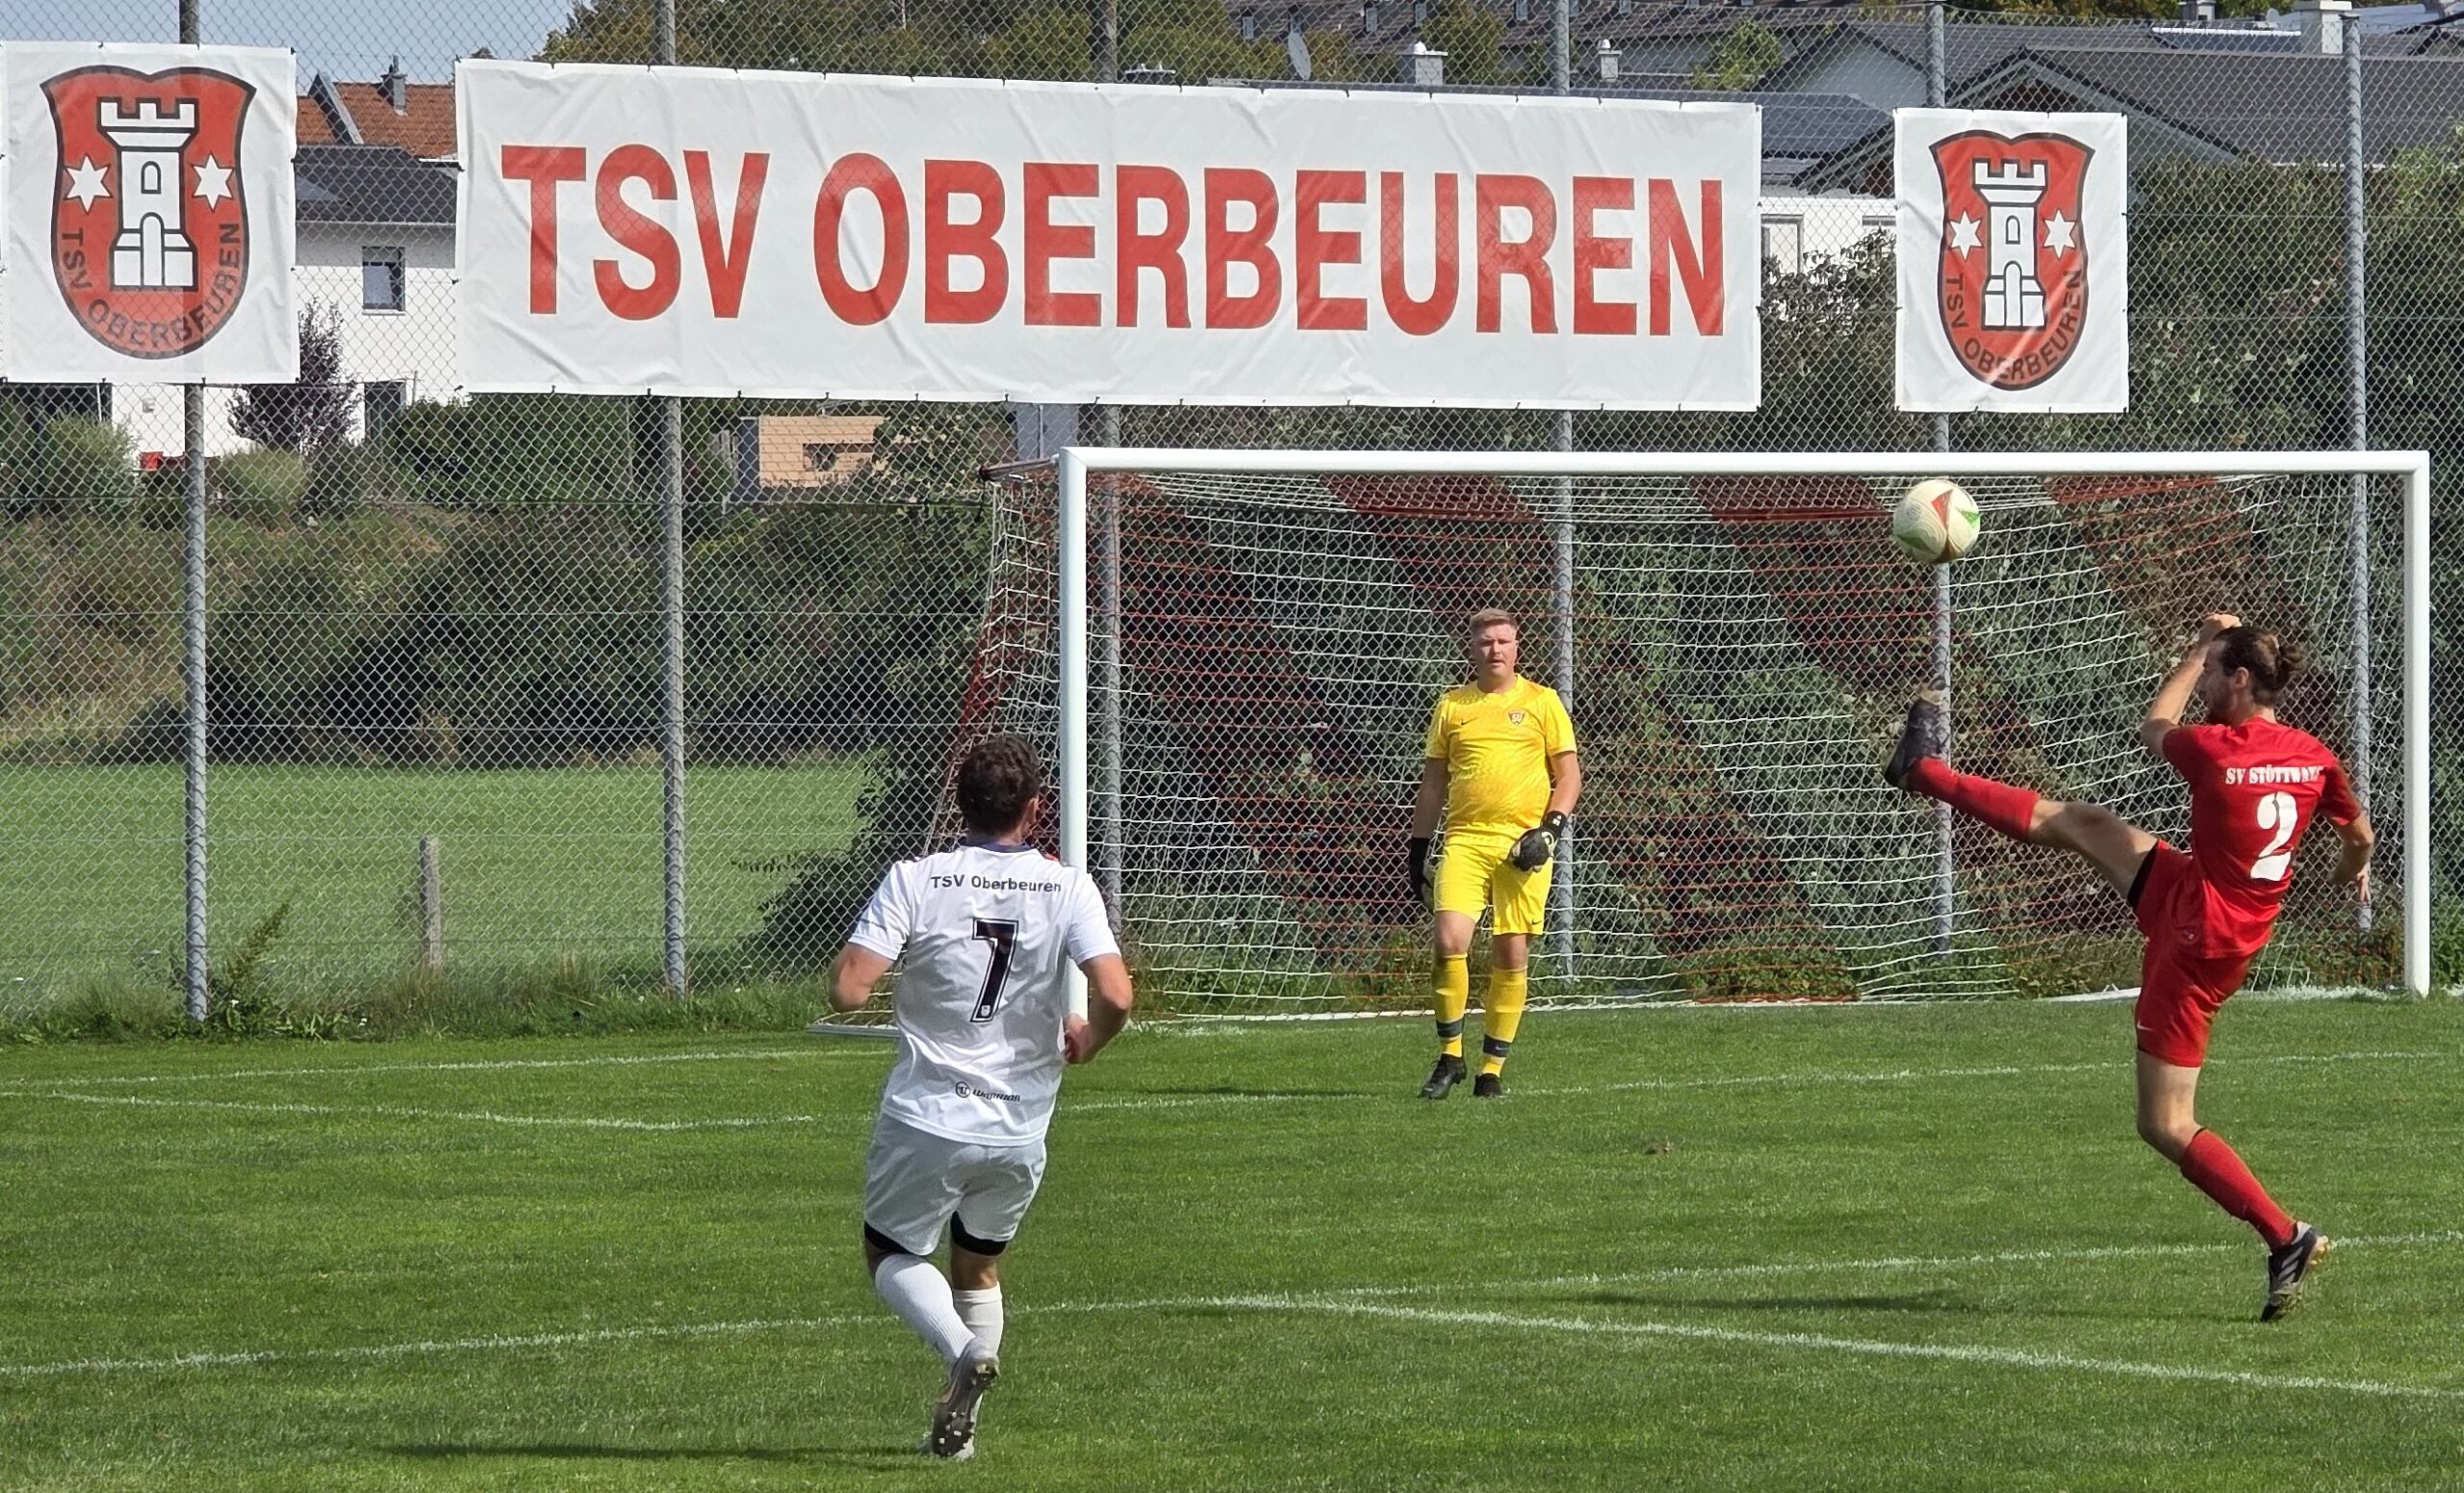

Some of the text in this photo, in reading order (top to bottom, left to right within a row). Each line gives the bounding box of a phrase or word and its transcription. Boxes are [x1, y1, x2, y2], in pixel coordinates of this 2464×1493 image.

[62, 223, 240, 347] TSV OBERBEUREN
[500, 143, 1725, 337] TSV OBERBEUREN
[1946, 270, 2081, 380] TSV OBERBEUREN
[2225, 767, 2246, 785] SV
[931, 874, 1062, 892] TSV Oberbeuren
[2250, 791, 2297, 881] 2
[970, 917, 1018, 1022] 7
